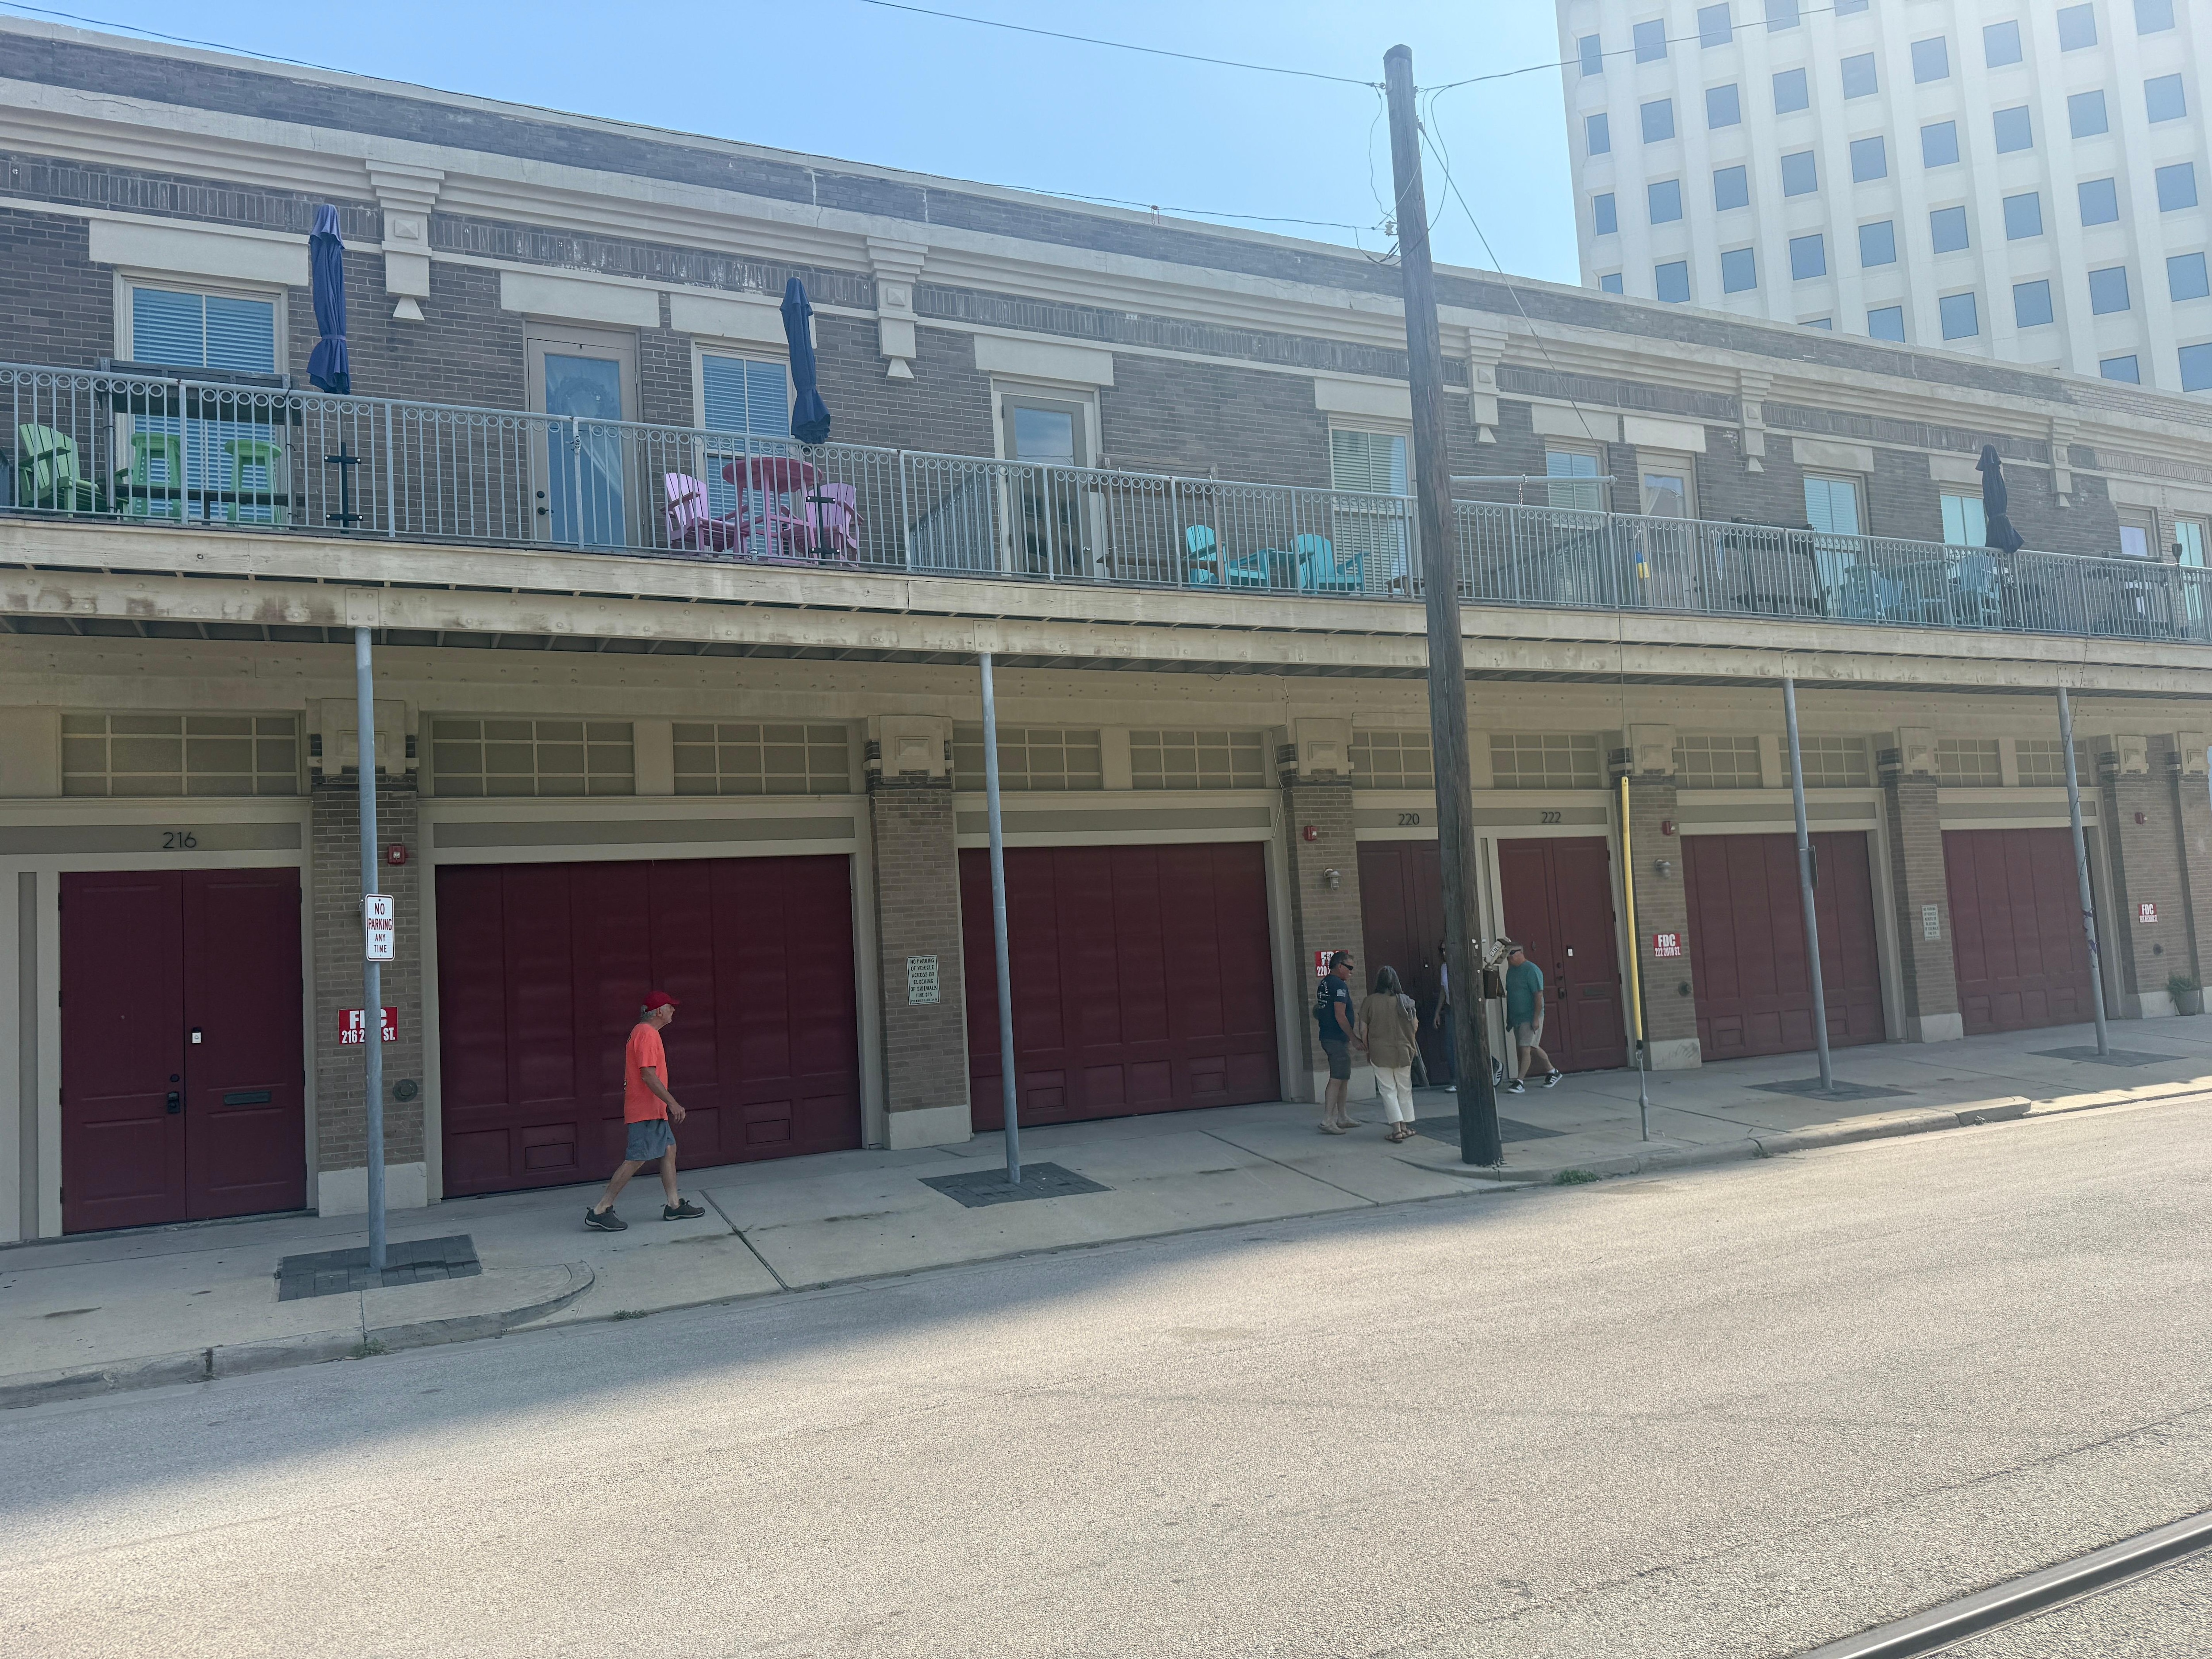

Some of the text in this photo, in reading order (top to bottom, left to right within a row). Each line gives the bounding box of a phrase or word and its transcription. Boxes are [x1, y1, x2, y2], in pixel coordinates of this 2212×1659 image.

[1398, 813, 1420, 826] 220
[1541, 811, 1562, 824] 222
[162, 831, 197, 849] 216
[374, 902, 385, 915] NO
[2141, 903, 2154, 916] FDC
[368, 918, 392, 931] PARKING
[375, 933, 386, 942] ANY
[1657, 933, 1676, 947] FDC
[374, 944, 387, 953] TIME
[1655, 947, 1663, 957] 222
[1663, 947, 1674, 956] 20TH
[1321, 950, 1336, 966] FD
[1317, 965, 1327, 976] 220
[341, 1029, 358, 1044] 216
[383, 1027, 396, 1041] ST.
